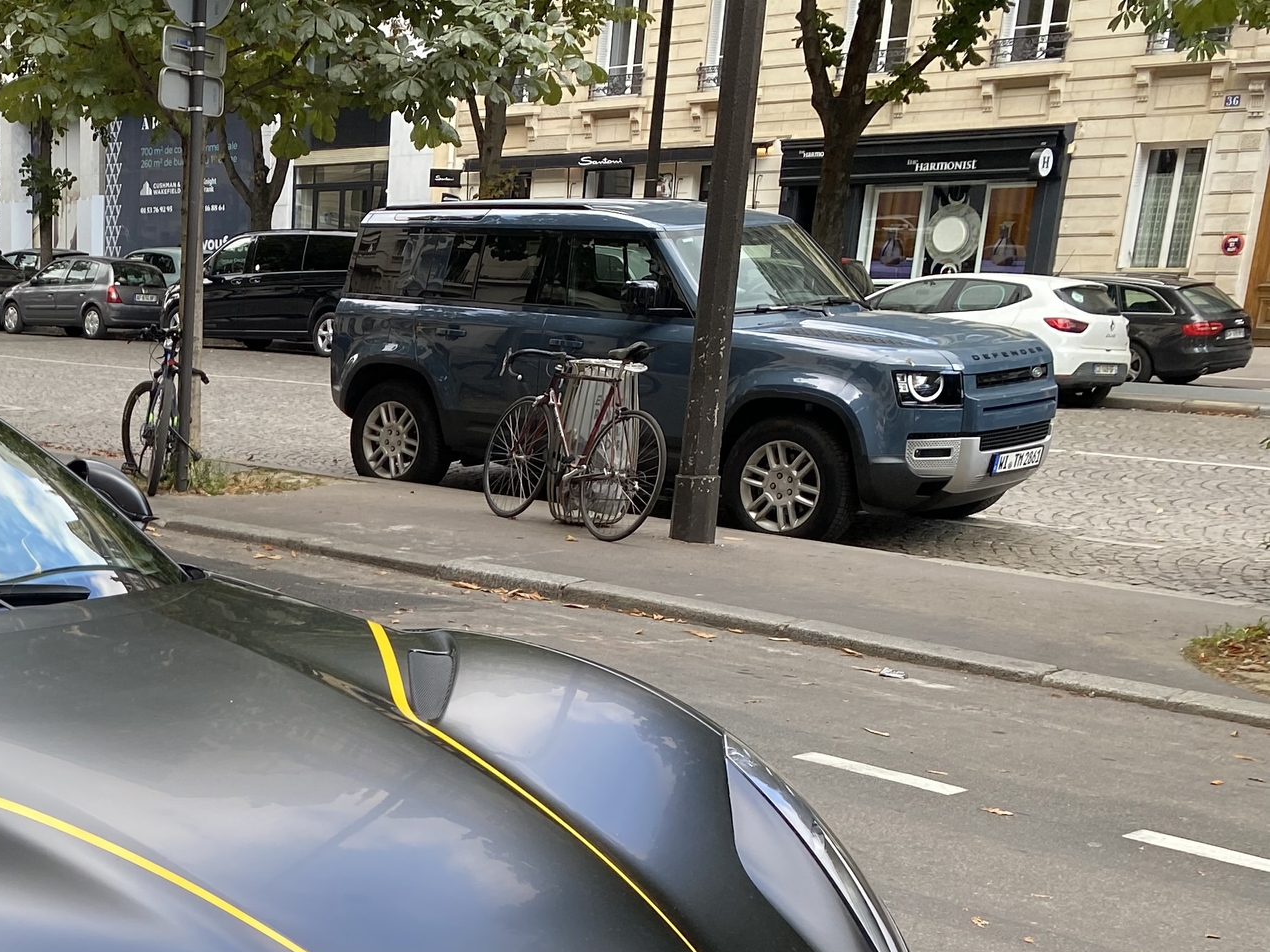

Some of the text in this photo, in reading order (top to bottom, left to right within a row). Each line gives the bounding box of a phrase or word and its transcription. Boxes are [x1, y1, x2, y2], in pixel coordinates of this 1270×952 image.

[1225, 95, 1239, 106] 36
[140, 147, 153, 156] 700
[164, 145, 173, 154] de
[140, 158, 153, 168] 260
[163, 157, 173, 166] de
[578, 156, 623, 166] Santoni
[1041, 148, 1050, 170] H
[972, 347, 1043, 360] DEFENDER
